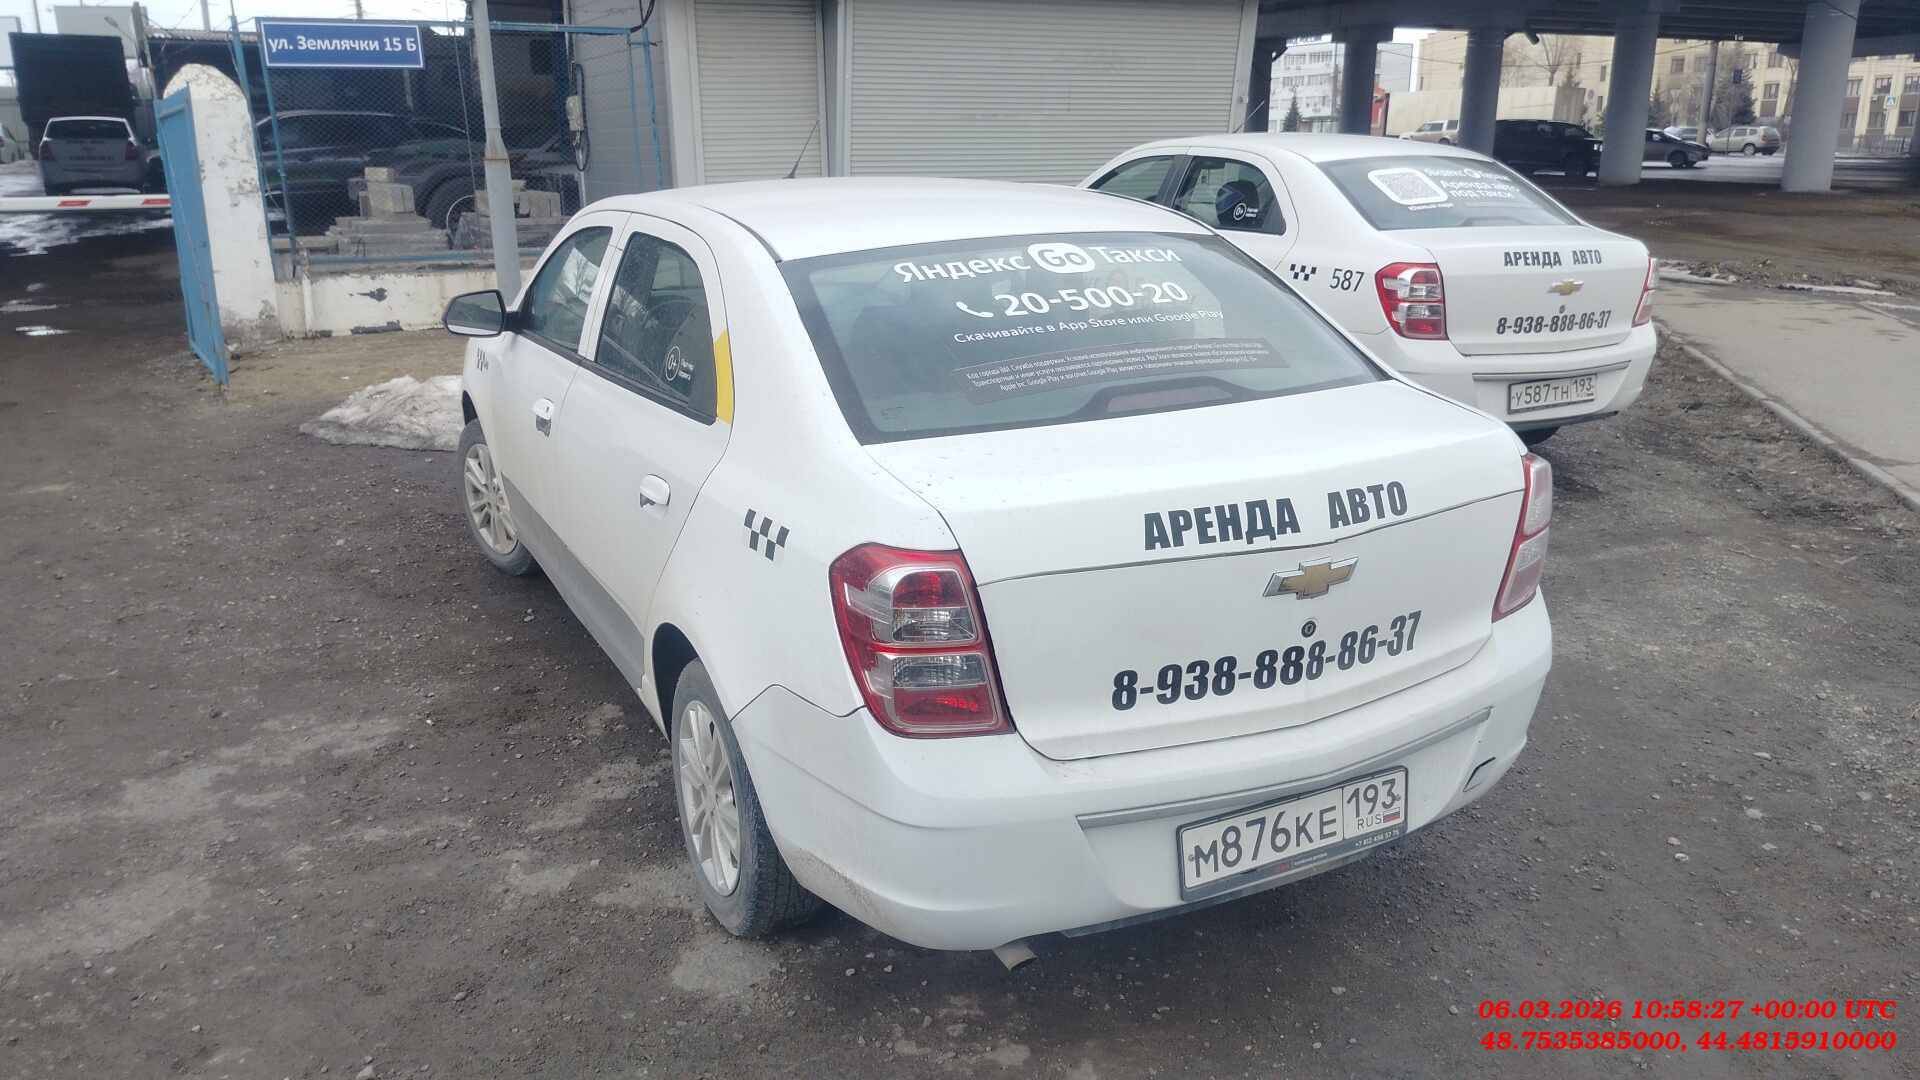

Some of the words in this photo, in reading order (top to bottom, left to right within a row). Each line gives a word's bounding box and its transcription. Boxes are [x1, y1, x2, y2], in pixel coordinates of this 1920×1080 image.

[268, 37, 293, 53] ул.
[296, 35, 380, 51] Землячки
[383, 37, 401, 52] 15
[406, 37, 417, 52] Б
[893, 254, 1032, 284] Яндекс
[1042, 248, 1090, 270] Go
[1086, 245, 1183, 266] Такси
[1503, 251, 1562, 269] АРЕНДА
[1572, 249, 1602, 266] АВТО
[1329, 268, 1365, 293] 587
[994, 281, 1189, 318] 20-500-20
[953, 325, 1044, 344] Скачивайте
[1047, 324, 1056, 333] в
[1059, 320, 1088, 334] App
[1089, 316, 1126, 329] Store
[1128, 315, 1153, 326] или
[1154, 311, 1197, 324] Google
[1198, 309, 1225, 322] Play
[1496, 309, 1612, 336] 8-938-888-86-37
[1516, 383, 1570, 406] У587ТН
[1572, 377, 1593, 393] 193
[1144, 497, 1301, 551] АРЕНДА
[1327, 480, 1408, 529] АВТО
[1111, 610, 1422, 711] 8-938-888-86-37
[1193, 804, 1338, 879] М876КЕ
[1346, 778, 1397, 819] 193
[1356, 813, 1384, 832] RUS
